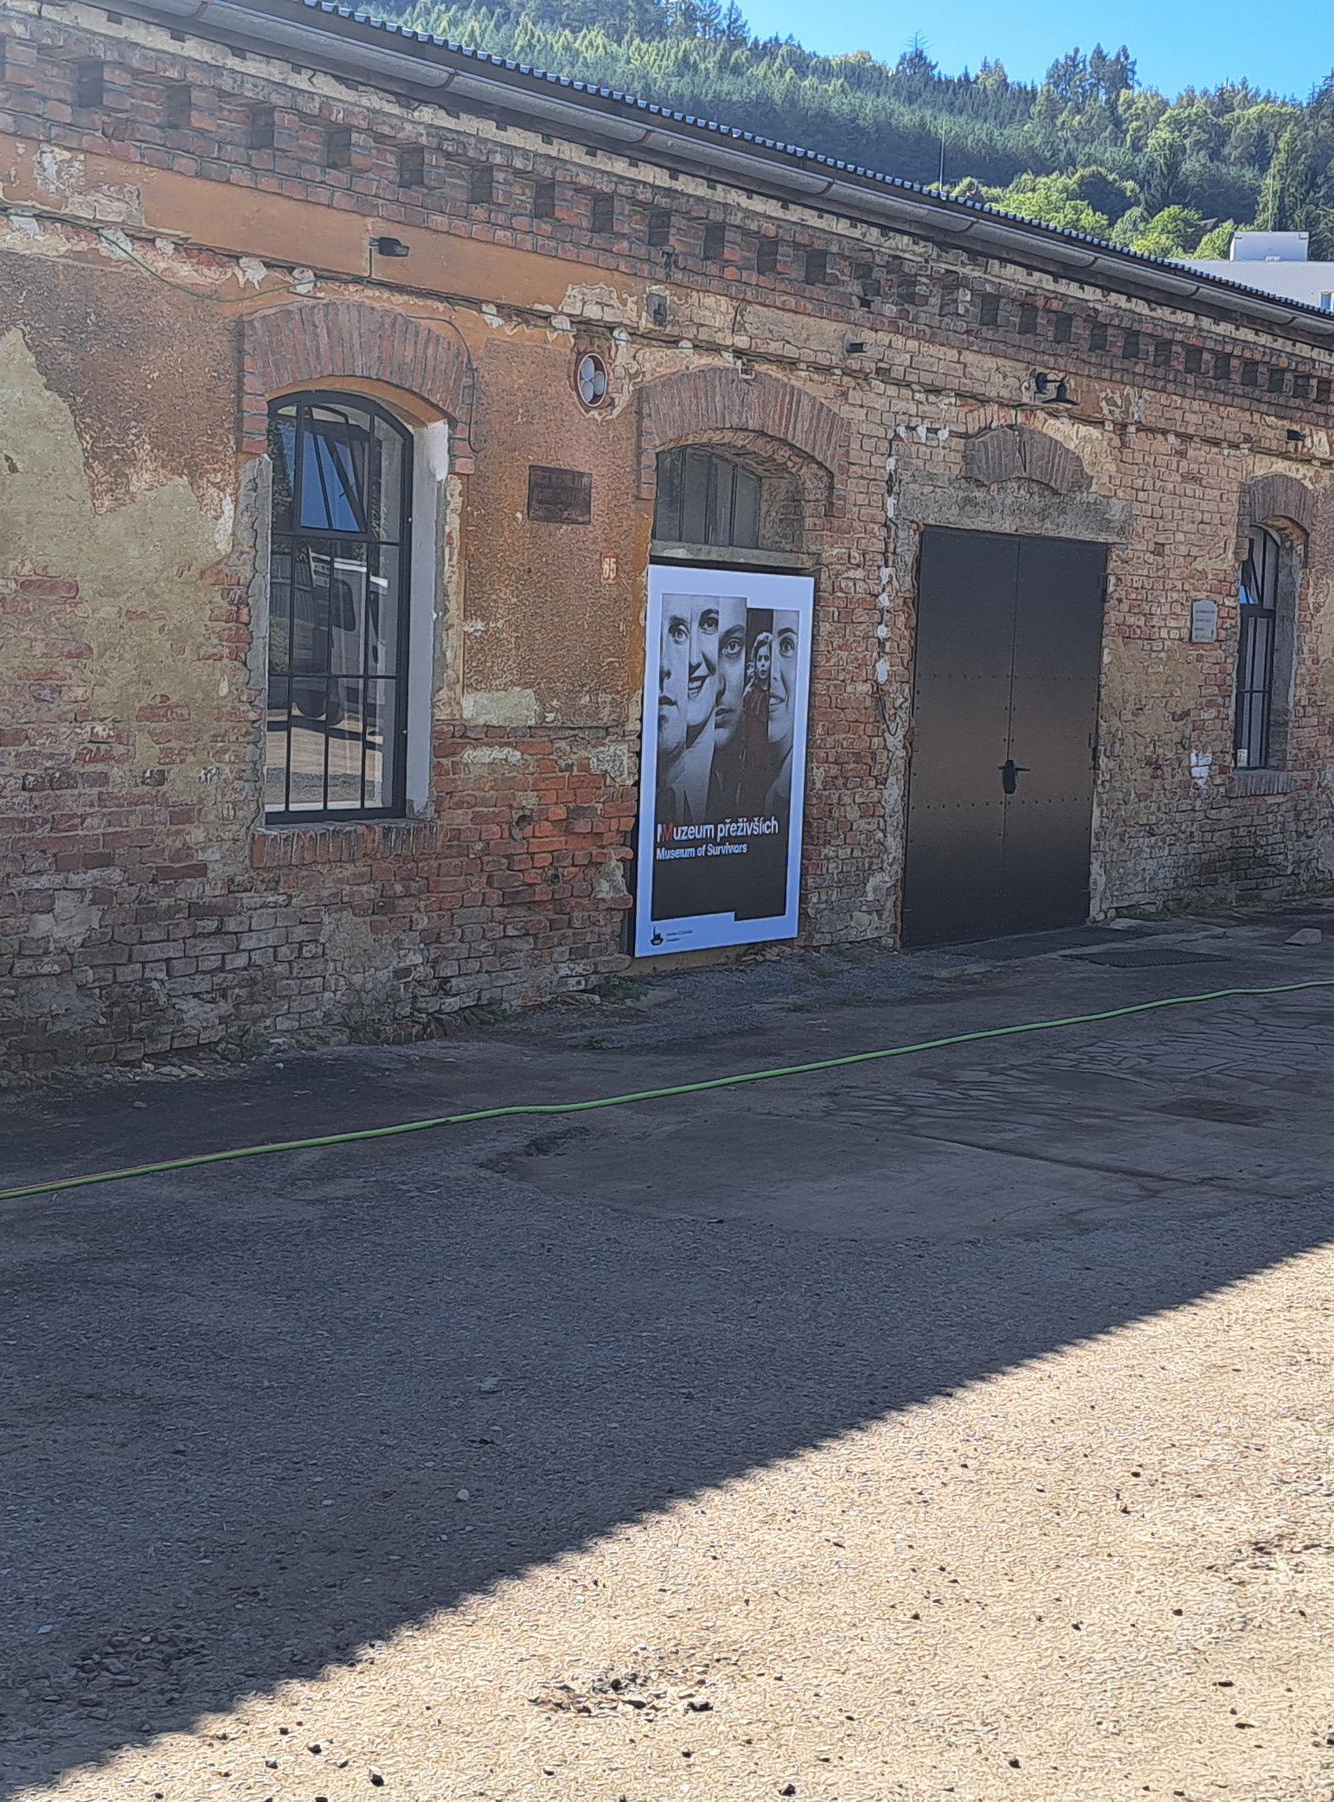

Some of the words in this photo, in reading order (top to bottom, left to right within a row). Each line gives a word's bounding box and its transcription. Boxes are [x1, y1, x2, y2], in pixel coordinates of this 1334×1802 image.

[656, 823, 715, 843] Muzeum
[656, 847, 696, 860] Museum
[697, 844, 706, 857] of
[707, 842, 748, 856] Survivors
